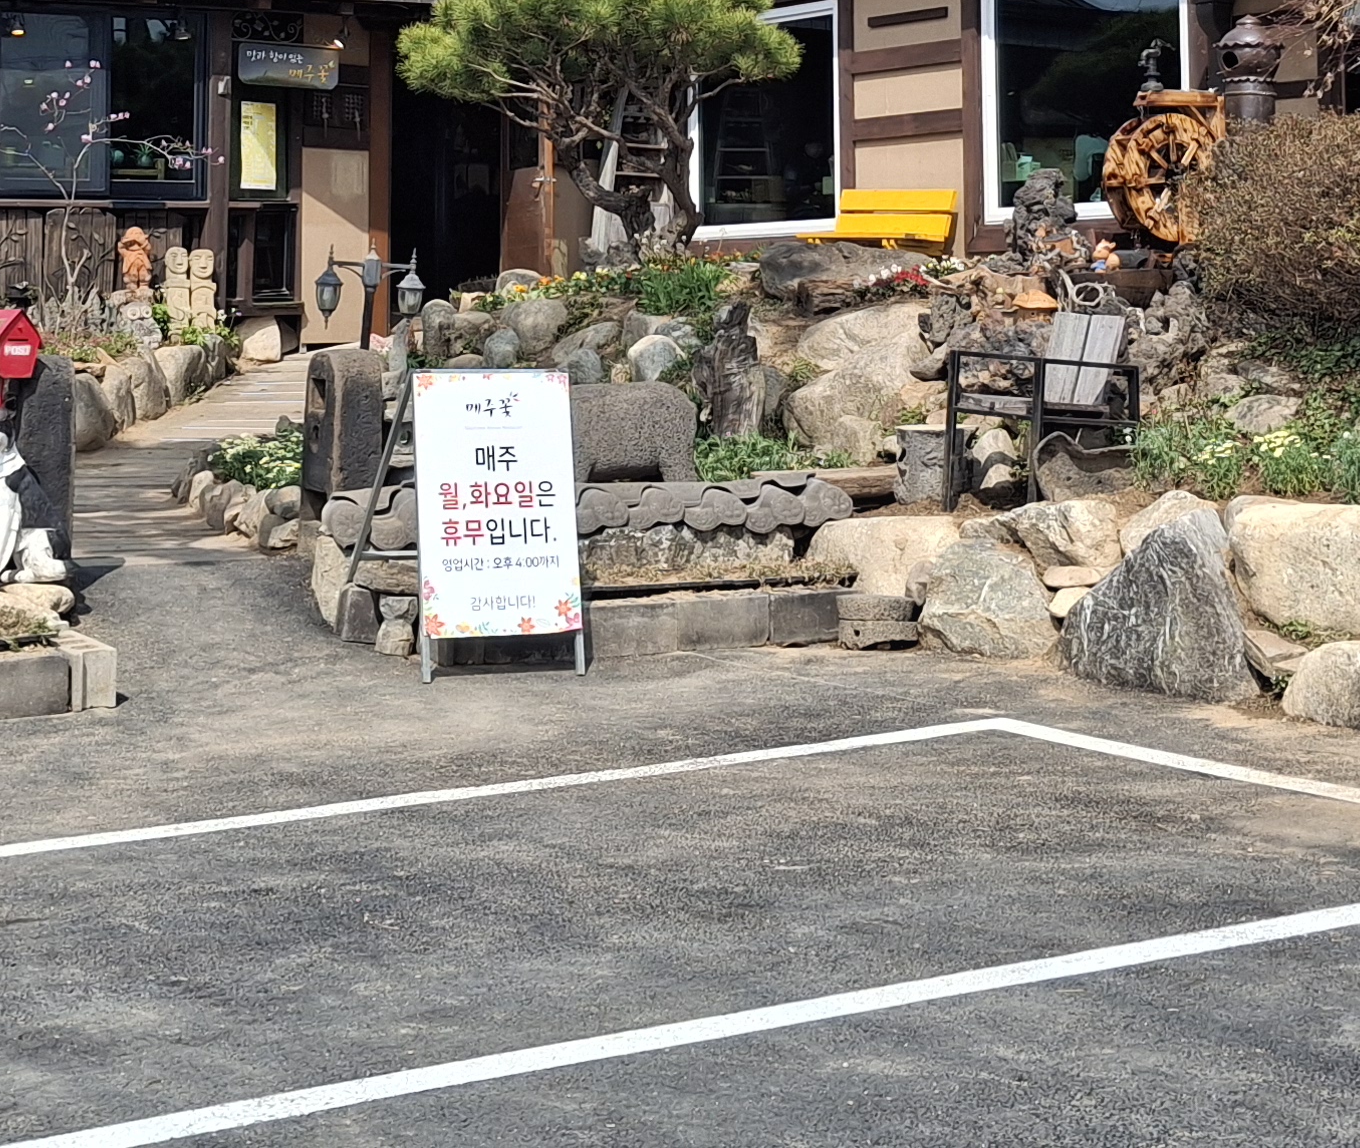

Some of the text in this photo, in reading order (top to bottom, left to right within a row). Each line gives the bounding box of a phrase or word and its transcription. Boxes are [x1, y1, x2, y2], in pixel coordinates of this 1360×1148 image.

[465, 397, 513, 418] 매주꽃
[475, 445, 518, 472] 매주
[438, 480, 556, 510] 월,화요일은
[440, 516, 557, 547] 휴무입니다.
[442, 557, 484, 572] 영업시간
[493, 556, 513, 570] 오후
[515, 554, 560, 568] 4:00까지
[471, 594, 537, 612] 감사합니다!
